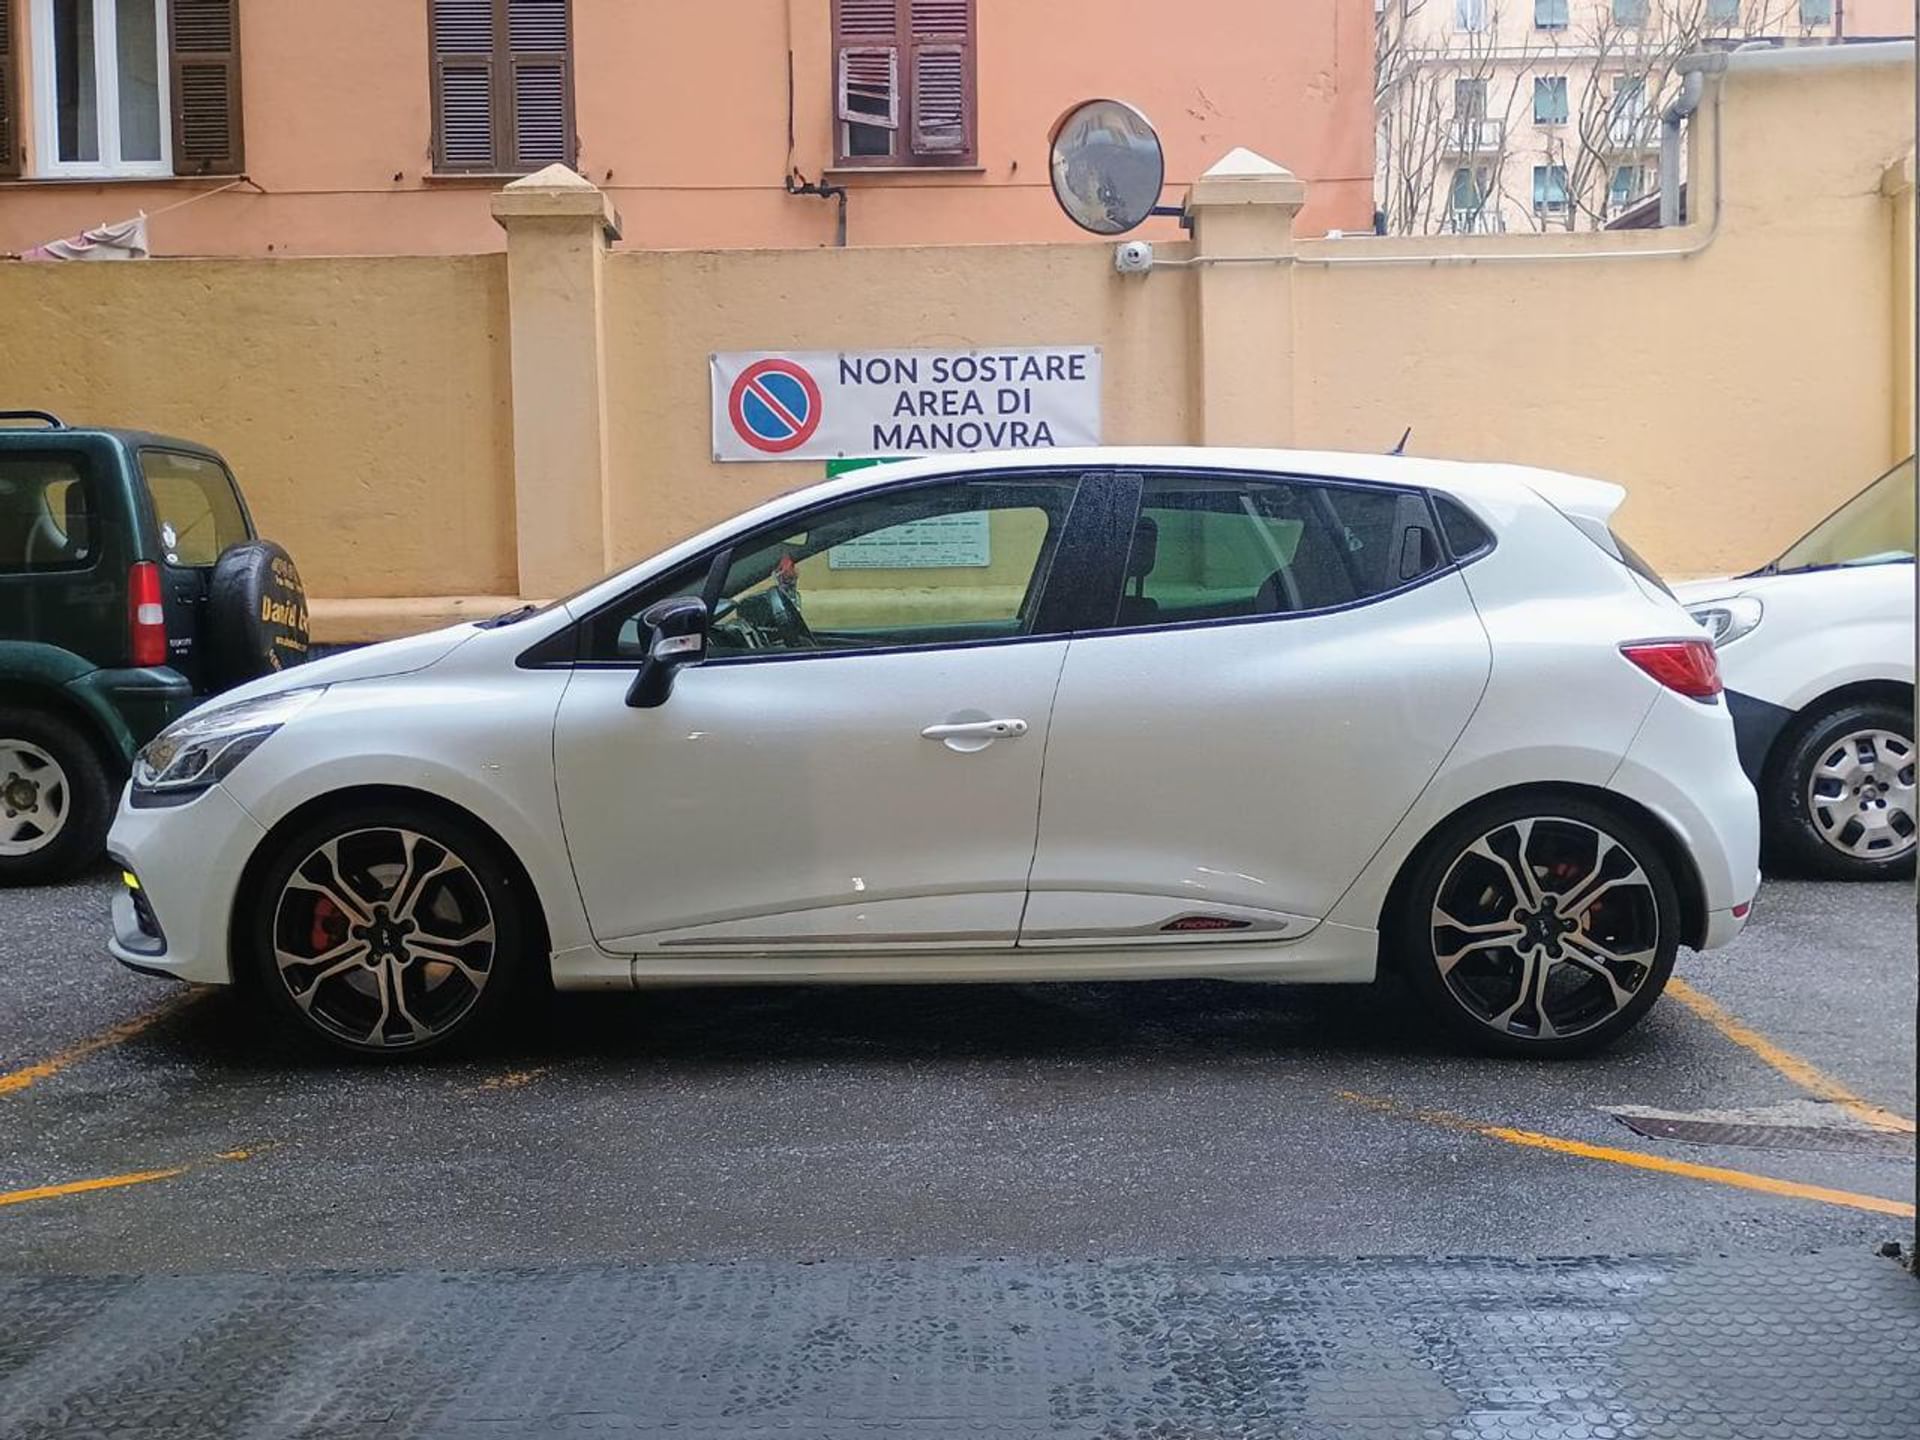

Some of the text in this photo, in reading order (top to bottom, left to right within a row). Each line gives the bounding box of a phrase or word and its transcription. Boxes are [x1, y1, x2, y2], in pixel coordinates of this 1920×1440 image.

[839, 354, 1086, 385] NON SOSTARE
[893, 388, 1031, 417] AREA DI
[873, 421, 1056, 451] MANOVRA
[262, 594, 297, 628] David
